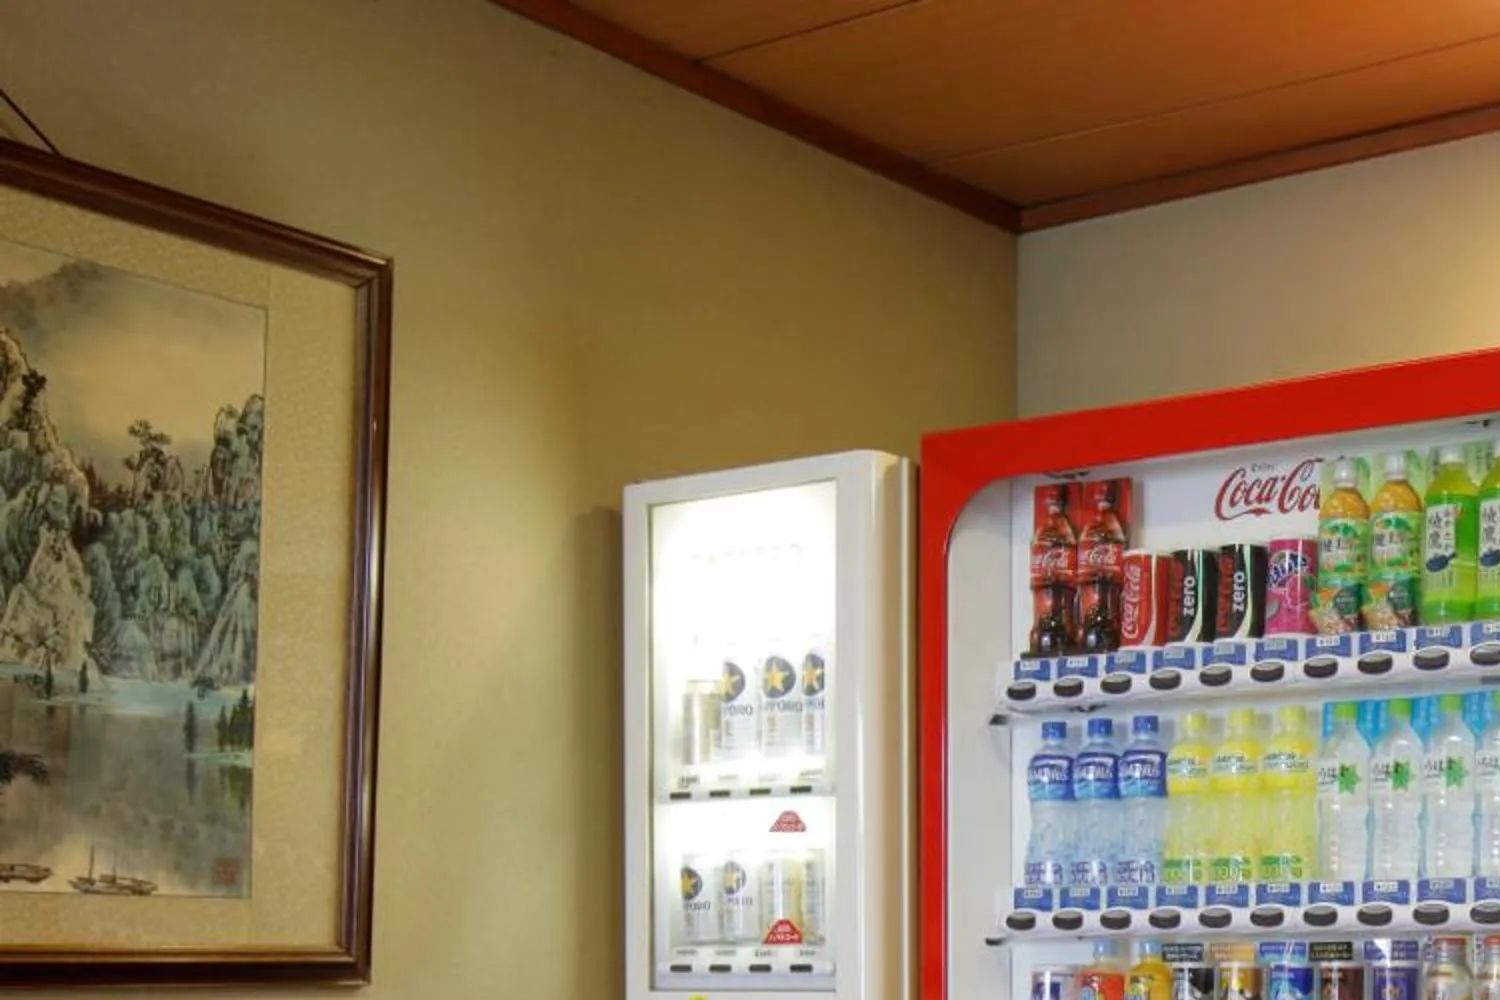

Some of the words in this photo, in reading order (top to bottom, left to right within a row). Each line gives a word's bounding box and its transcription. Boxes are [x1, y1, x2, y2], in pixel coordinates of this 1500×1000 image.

[1215, 458, 1324, 520] Coca-Co
[1183, 575, 1196, 617] zero
[1232, 571, 1246, 612] zero
